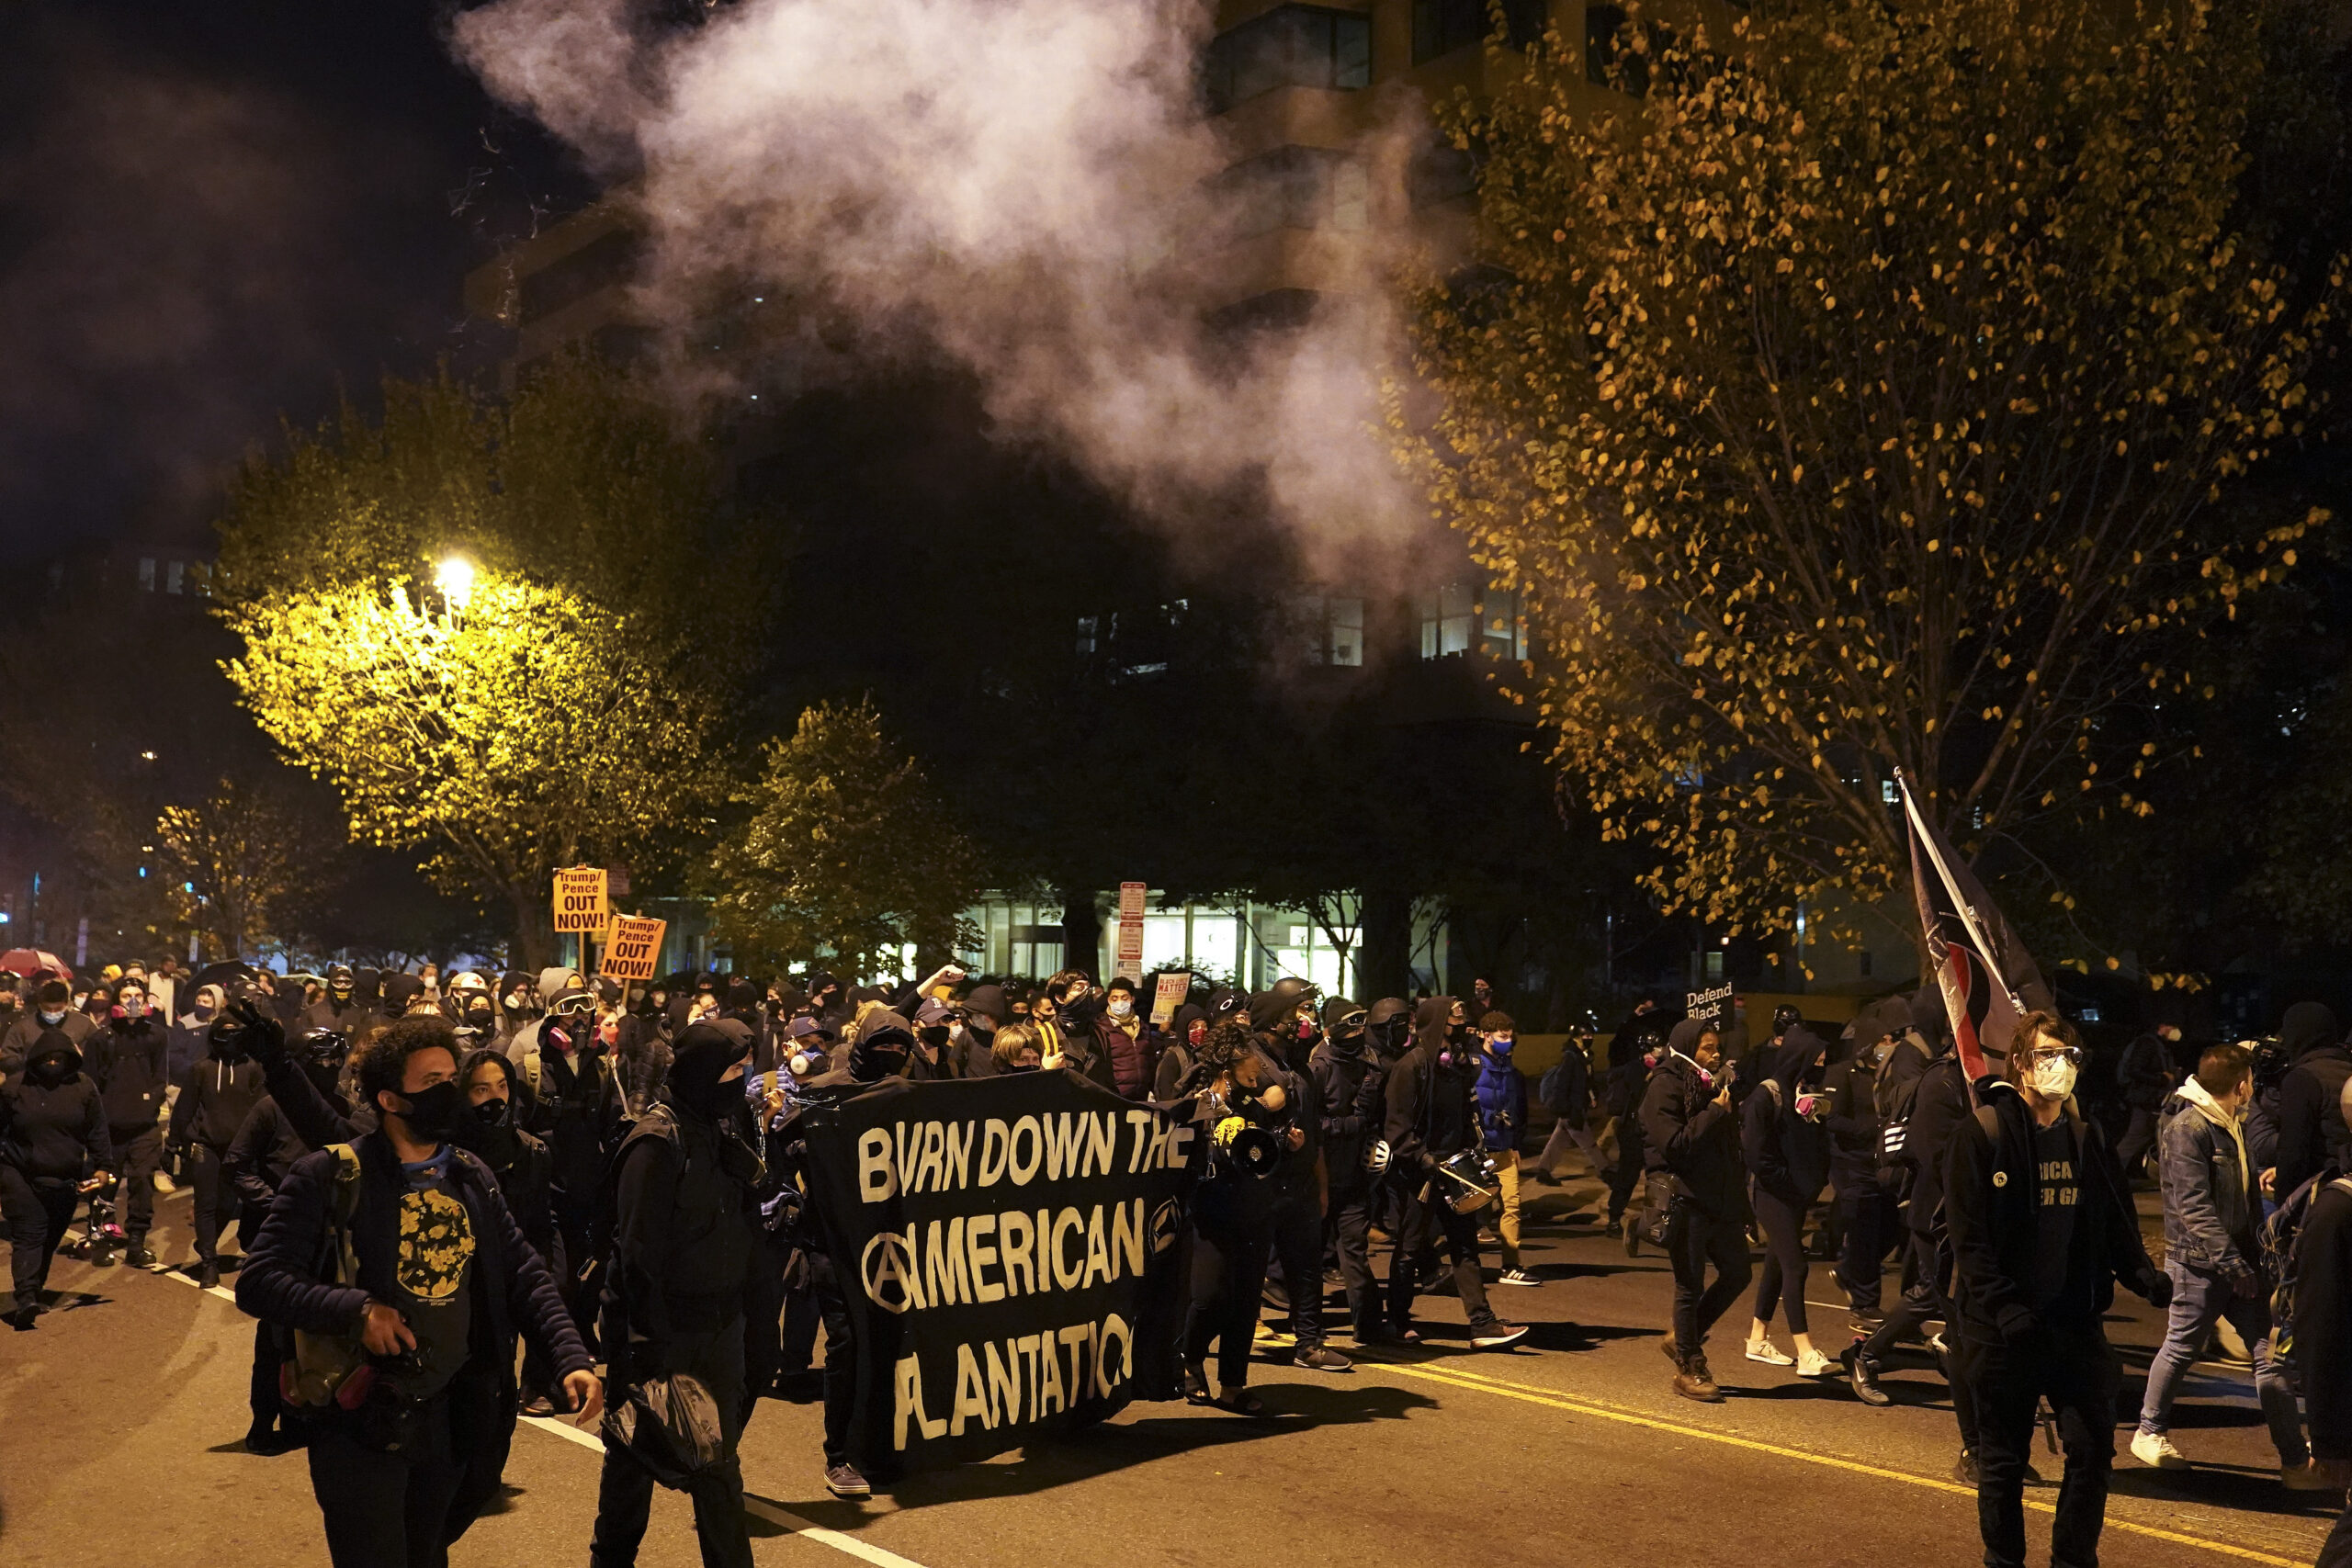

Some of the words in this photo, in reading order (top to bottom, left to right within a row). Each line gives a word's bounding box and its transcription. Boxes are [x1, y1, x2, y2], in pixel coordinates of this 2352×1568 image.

[560, 872, 602, 884] Trump/
[562, 884, 599, 894] Pence
[564, 896, 598, 911] OUT
[557, 913, 604, 929] NOW!
[617, 919, 662, 932] Trump/
[616, 930, 655, 942] Pence
[616, 942, 651, 959] OUT
[604, 958, 653, 977] NOW!
[1158, 984, 1188, 993] MATTER
[1686, 981, 1734, 1008] Defend
[1687, 1001, 1722, 1020] Black
[978, 1111, 1116, 1187] DOWN
[1125, 1109, 1195, 1174] THE
[2039, 1160, 2074, 1181] ICA
[861, 1197, 1146, 1314] AMERICAN
